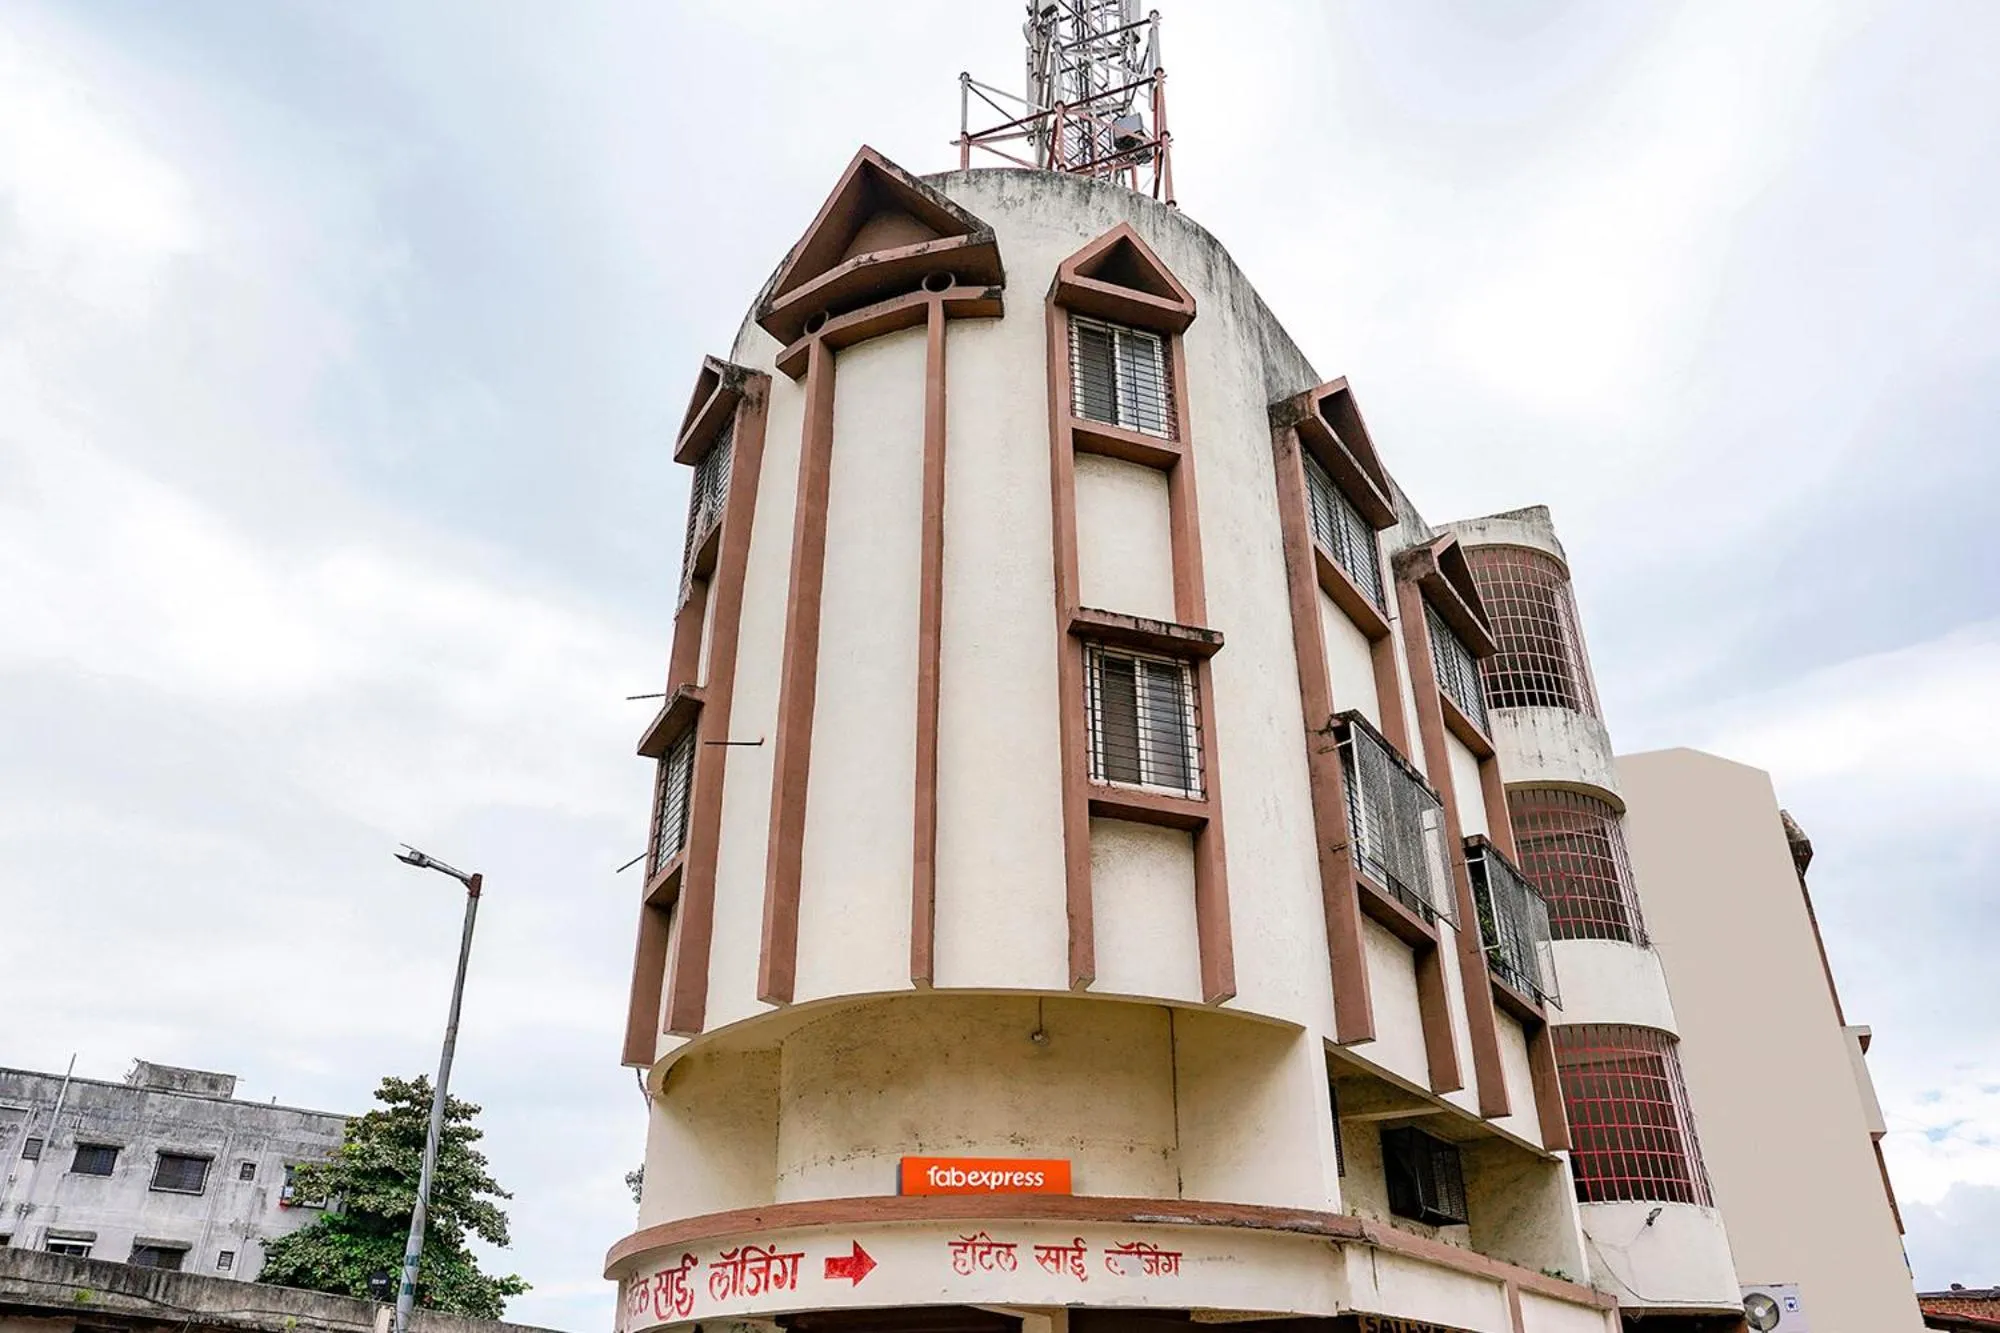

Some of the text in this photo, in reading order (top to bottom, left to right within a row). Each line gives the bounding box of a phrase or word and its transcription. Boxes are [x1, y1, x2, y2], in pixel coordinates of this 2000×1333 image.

[927, 1165, 1045, 1190] fabexpress
[709, 1244, 805, 1301] लॉजिंग
[948, 1232, 1018, 1276] हॉटेल
[1034, 1236, 1088, 1282] साई
